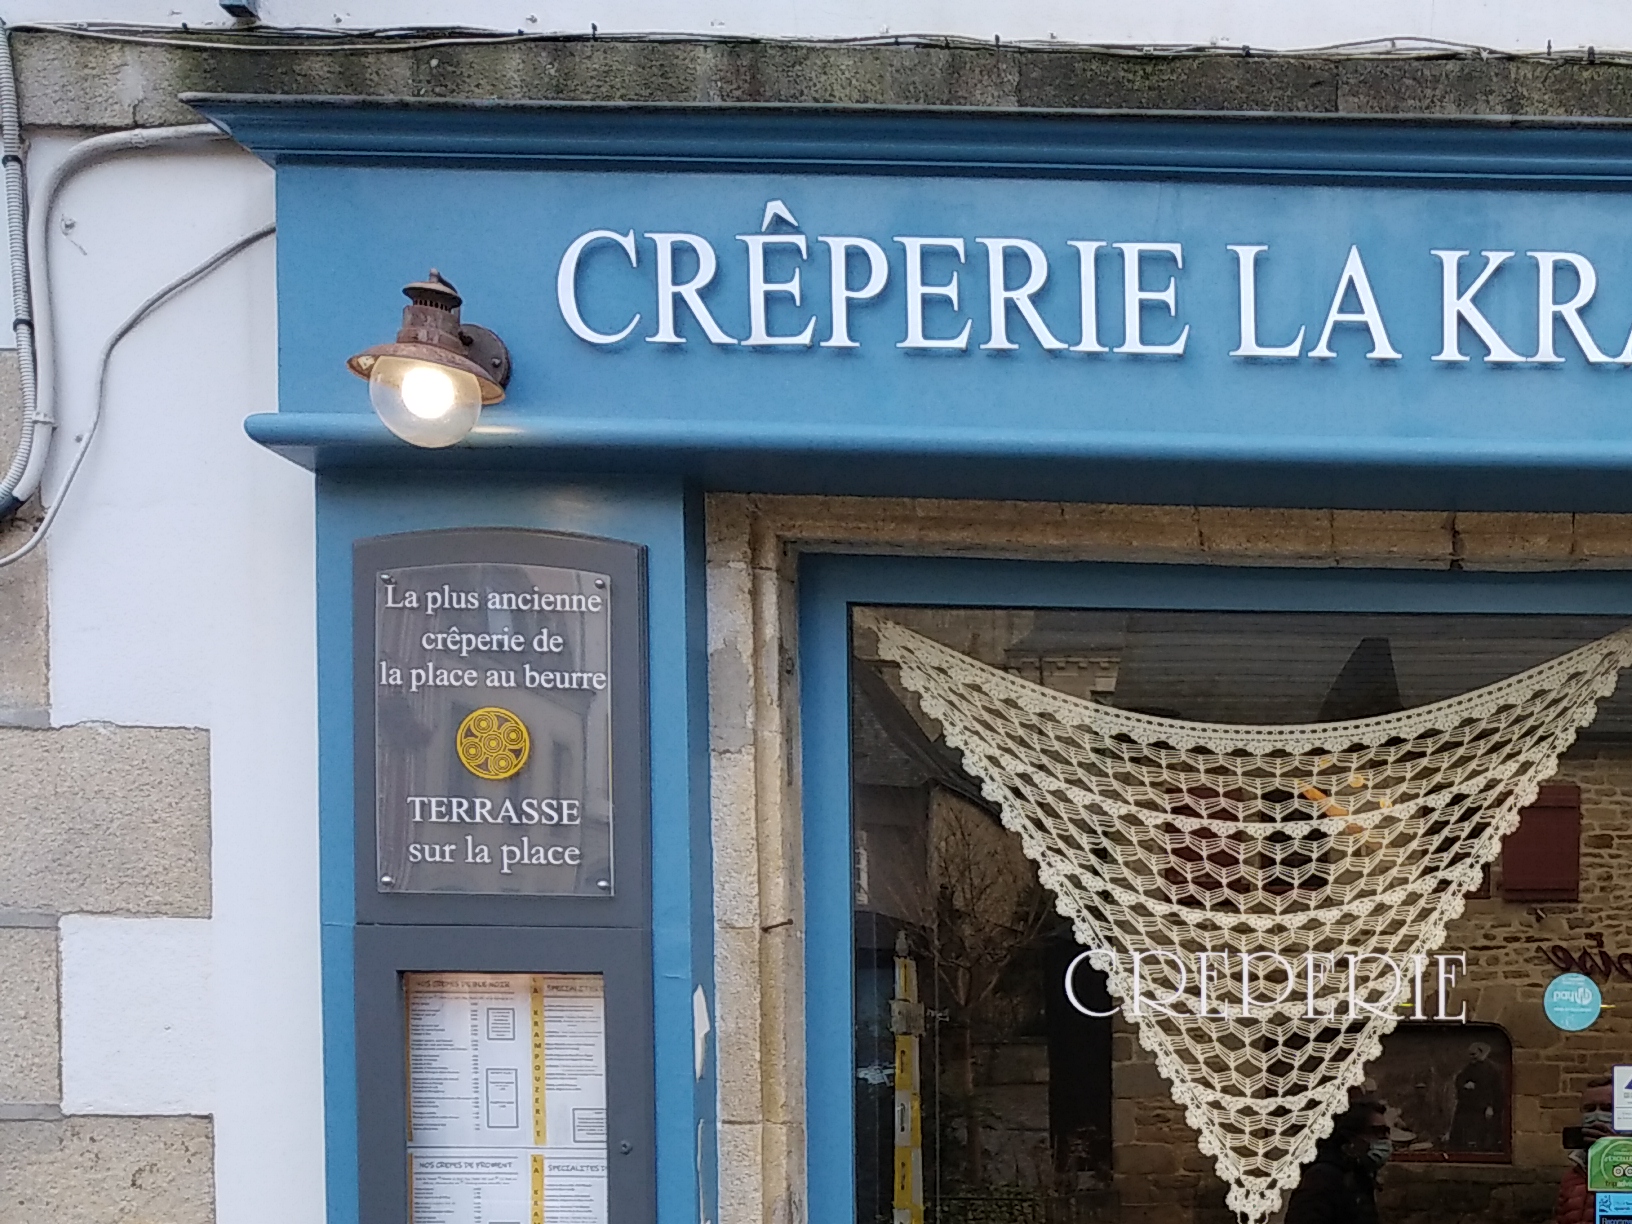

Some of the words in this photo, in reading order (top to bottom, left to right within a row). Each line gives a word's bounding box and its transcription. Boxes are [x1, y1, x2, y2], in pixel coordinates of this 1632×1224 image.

[557, 200, 1190, 355] CRÊPERIE
[1227, 245, 1402, 359] LA
[384, 585, 419, 610] La
[426, 585, 479, 616] plus
[487, 587, 603, 613] ancienne
[421, 626, 525, 657] crêperie
[532, 626, 564, 653] de
[379, 662, 403, 688] la
[409, 662, 479, 693] place
[485, 669, 517, 689] au
[523, 663, 607, 692] beurre
[406, 796, 581, 826] TERRASSE
[408, 843, 457, 864] sur
[464, 835, 492, 865] la
[500, 836, 581, 875] place
[1063, 947, 1468, 1025] CREPERIE
[475, 1161, 513, 1169] FROMENT
[547, 1164, 600, 1172] SPECIALITES
